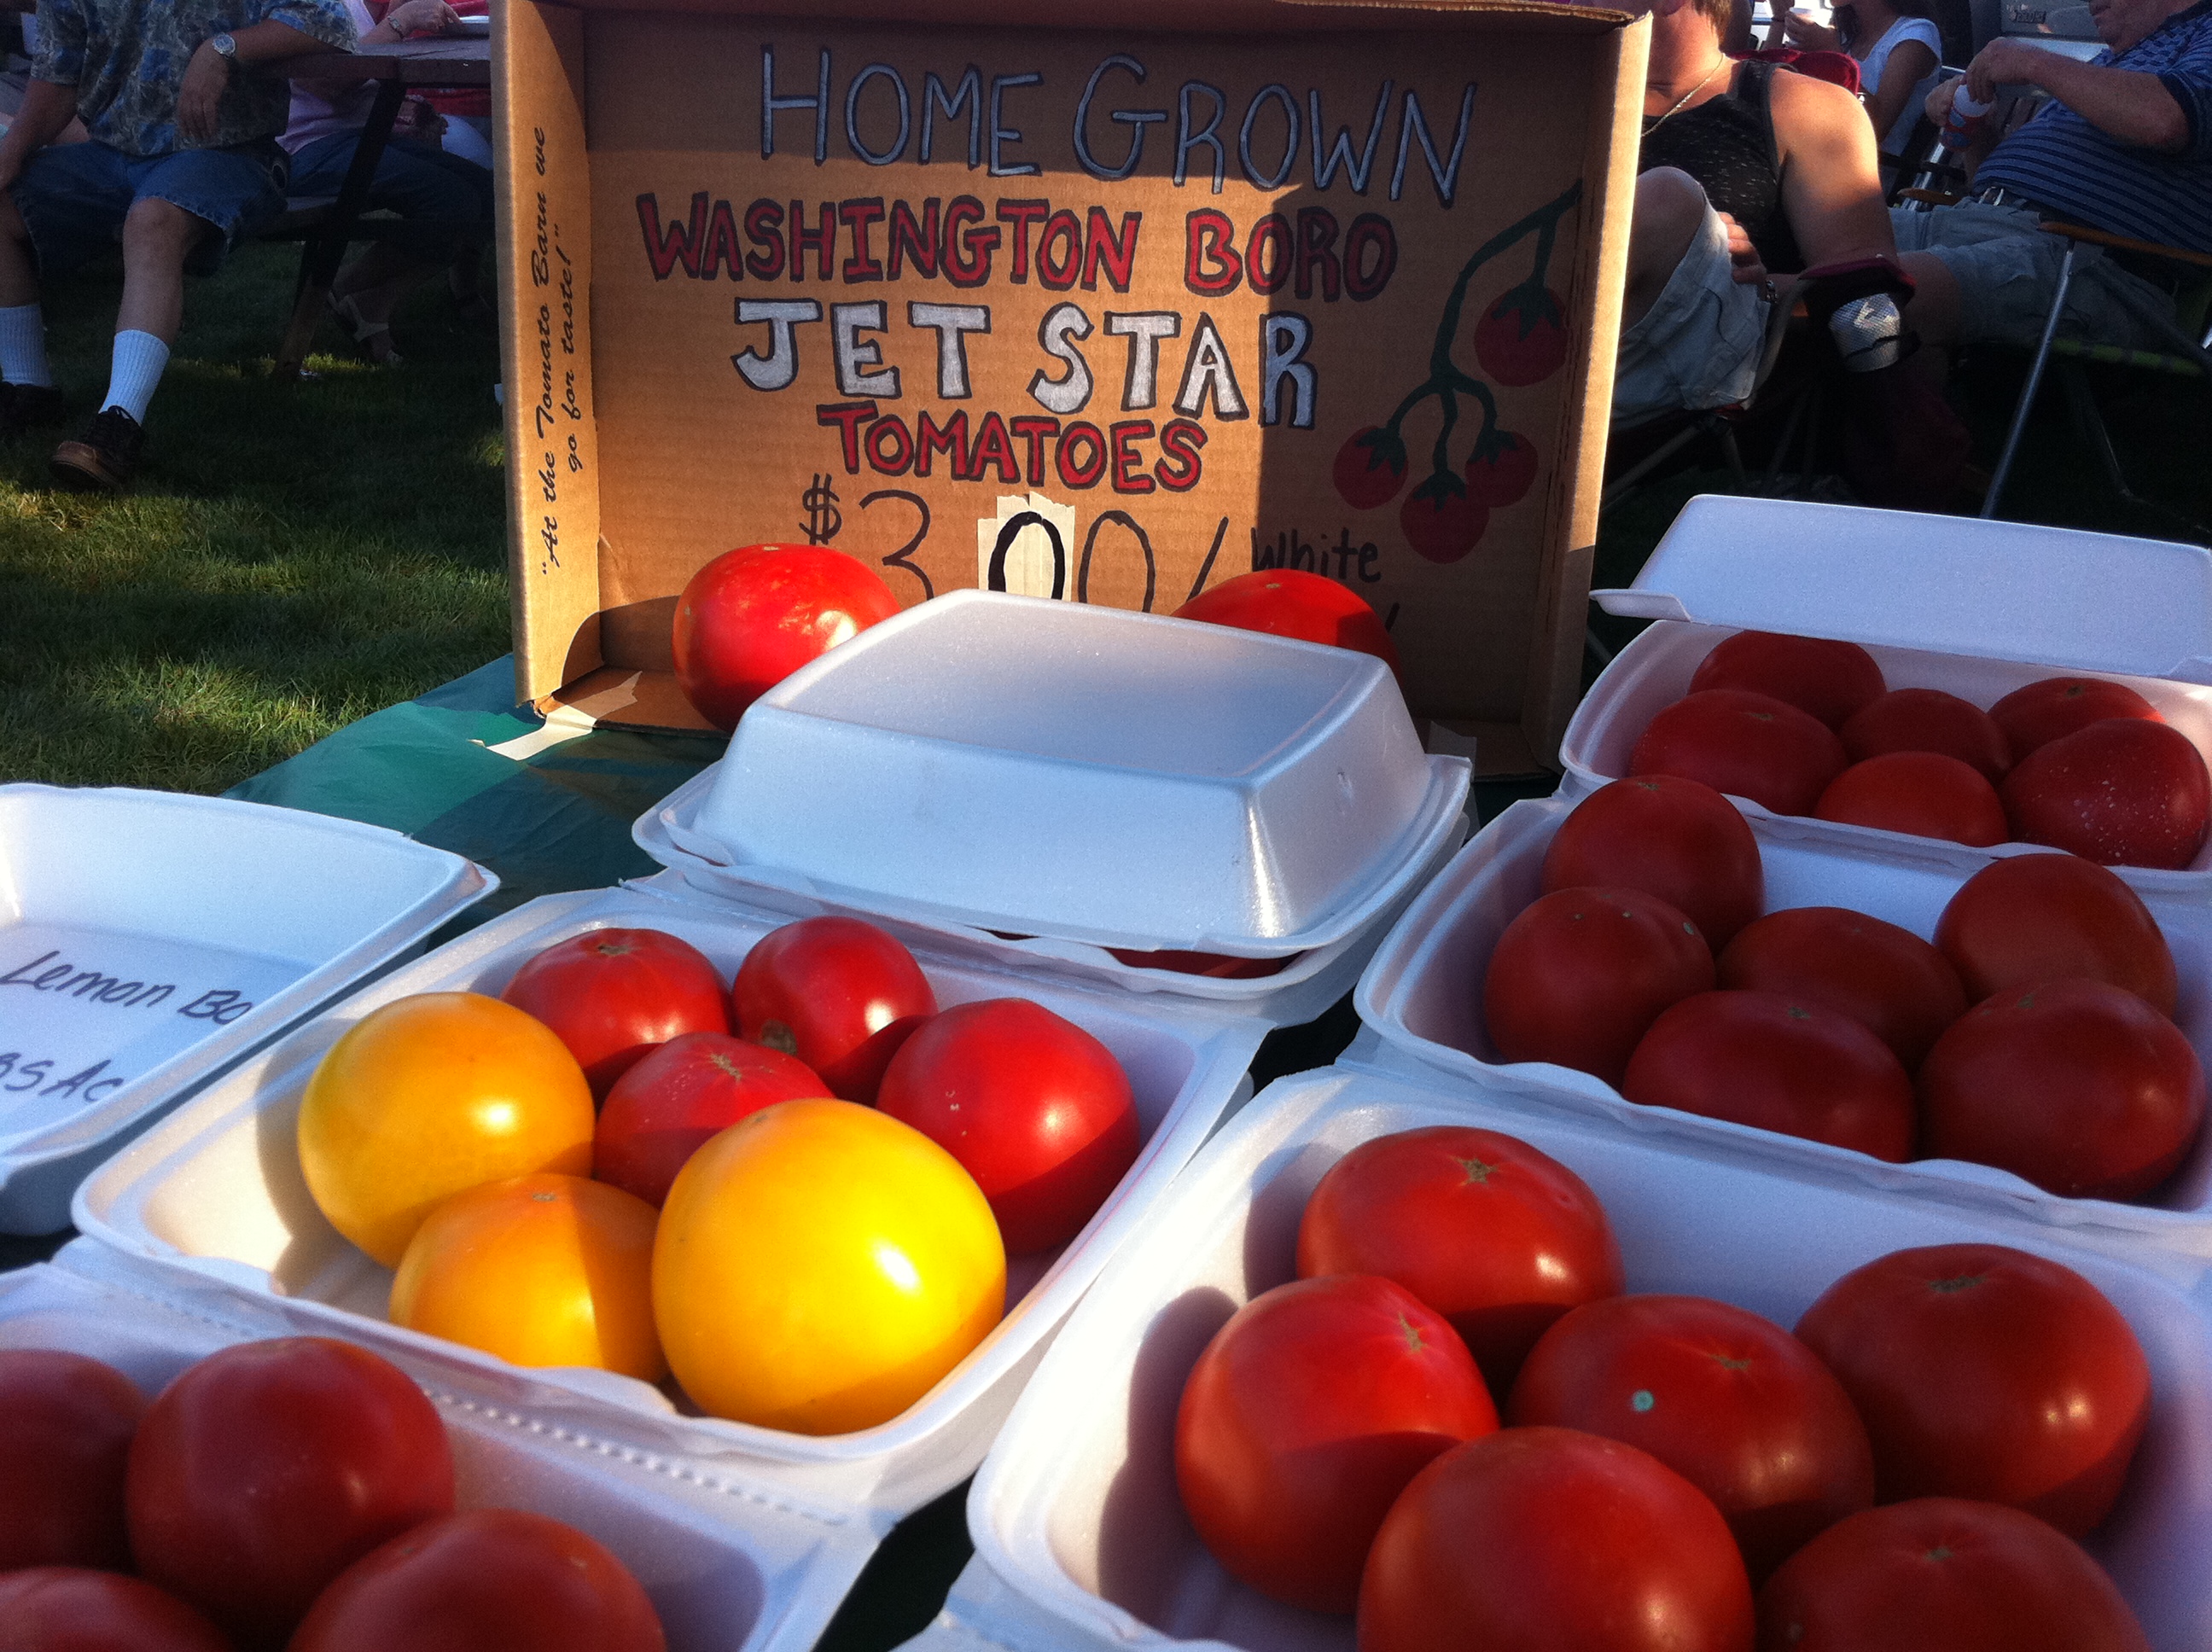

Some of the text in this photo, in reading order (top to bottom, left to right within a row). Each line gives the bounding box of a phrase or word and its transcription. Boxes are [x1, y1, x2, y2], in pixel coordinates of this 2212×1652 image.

[534, 127, 545, 177] we
[760, 44, 1477, 210] HOME GROWN
[531, 190, 550, 288] Barn
[635, 190, 1399, 302] WASHINGTON BORO
[535, 302, 556, 439] Tomato
[562, 370, 582, 421] for
[731, 297, 1318, 429] JET STAR
[538, 451, 556, 503] the
[567, 433, 583, 473] go
[816, 401, 1209, 494] TOMATOES
[0, 950, 176, 1009] Lemon
